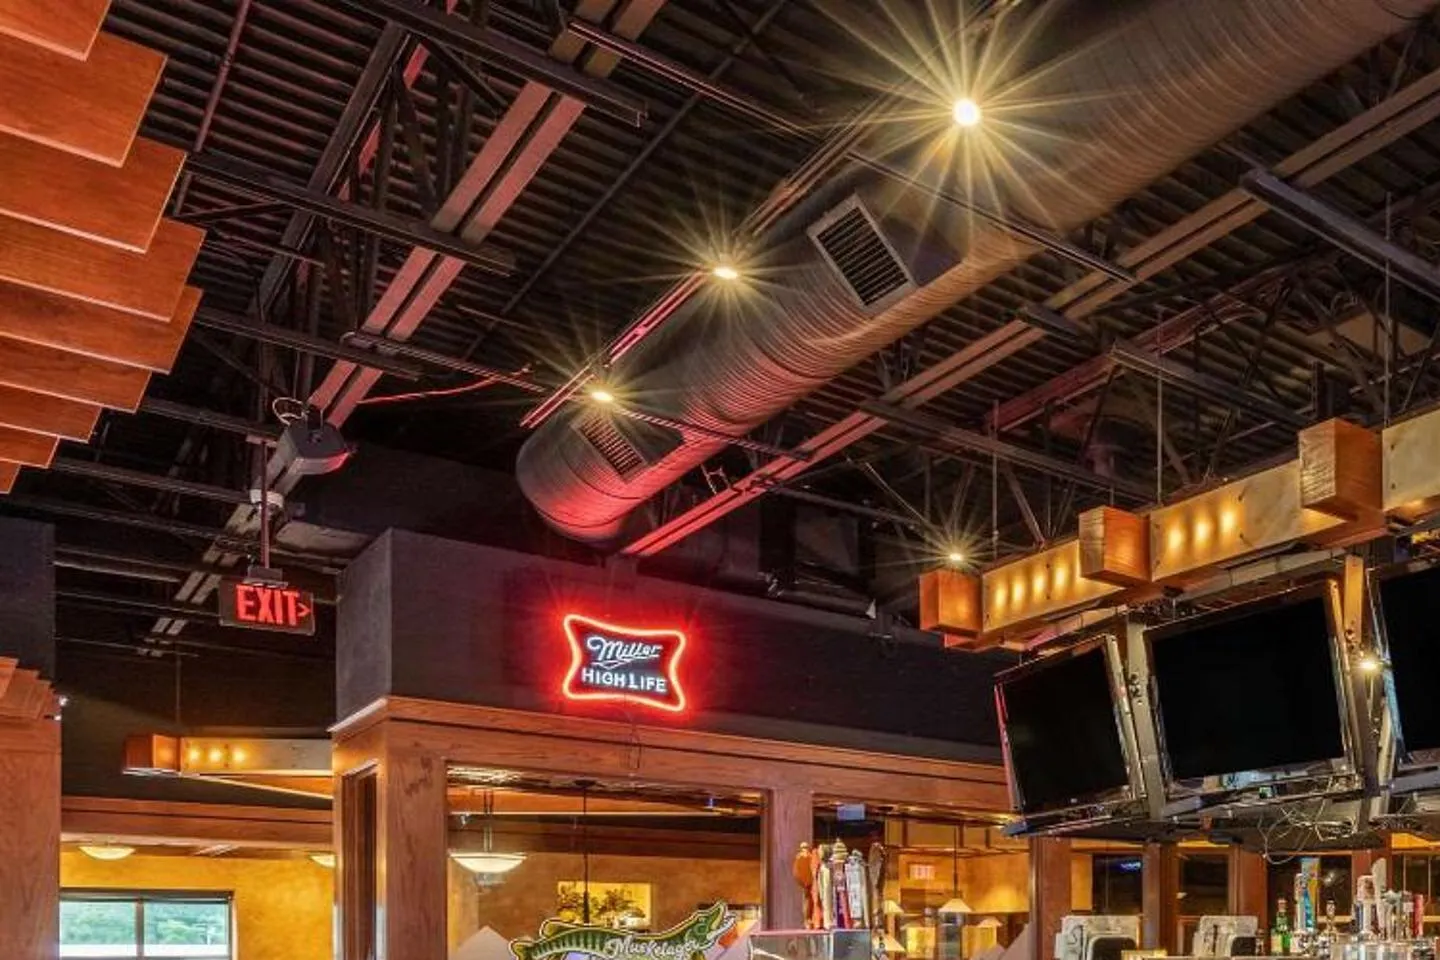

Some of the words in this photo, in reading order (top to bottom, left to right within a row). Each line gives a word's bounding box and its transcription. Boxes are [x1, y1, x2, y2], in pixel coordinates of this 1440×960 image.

[236, 584, 300, 626] EXIT
[586, 635, 664, 661] Miller
[581, 667, 626, 688] HIGH
[628, 673, 668, 693] LIFE
